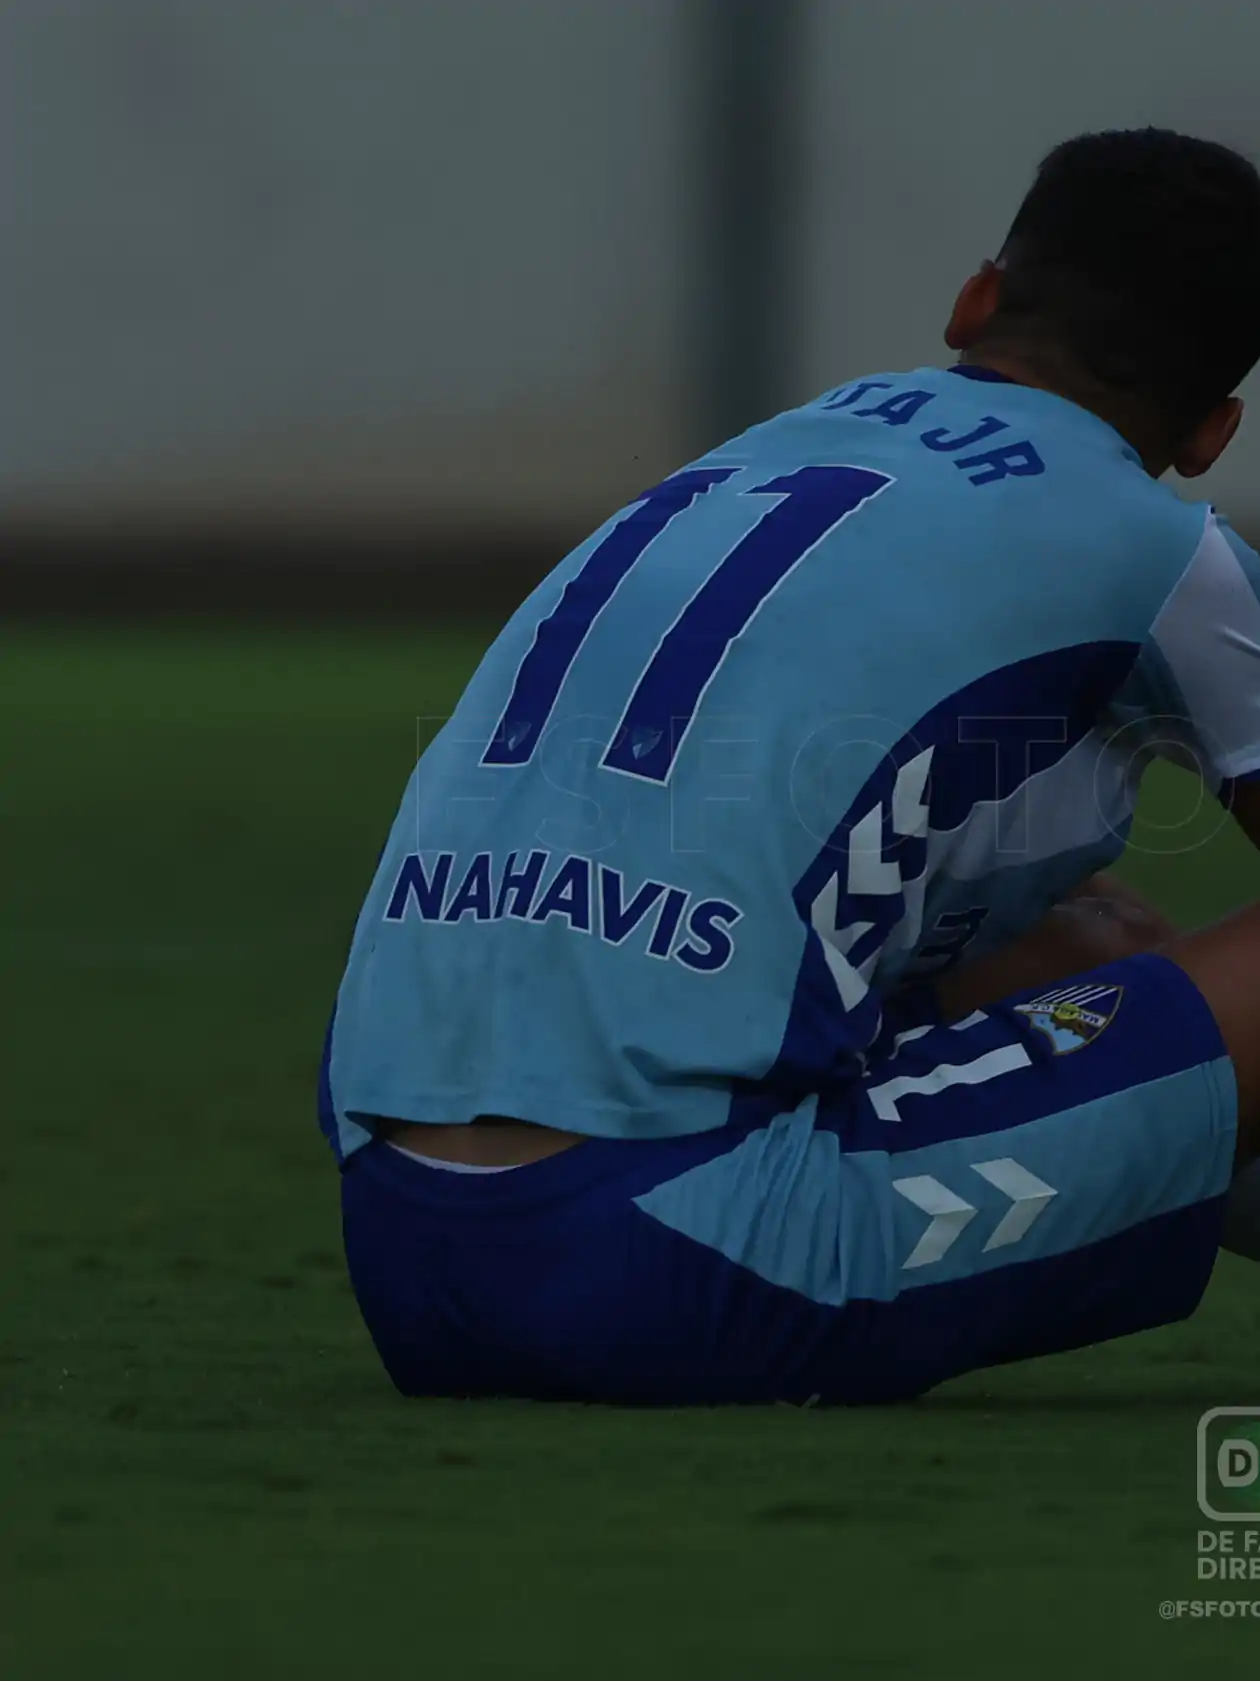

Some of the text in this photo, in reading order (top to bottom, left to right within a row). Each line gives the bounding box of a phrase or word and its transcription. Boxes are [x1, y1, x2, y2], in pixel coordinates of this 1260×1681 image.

[920, 416, 1046, 486] JR
[478, 464, 898, 787] 11
[383, 849, 745, 974] NAHAVIS
